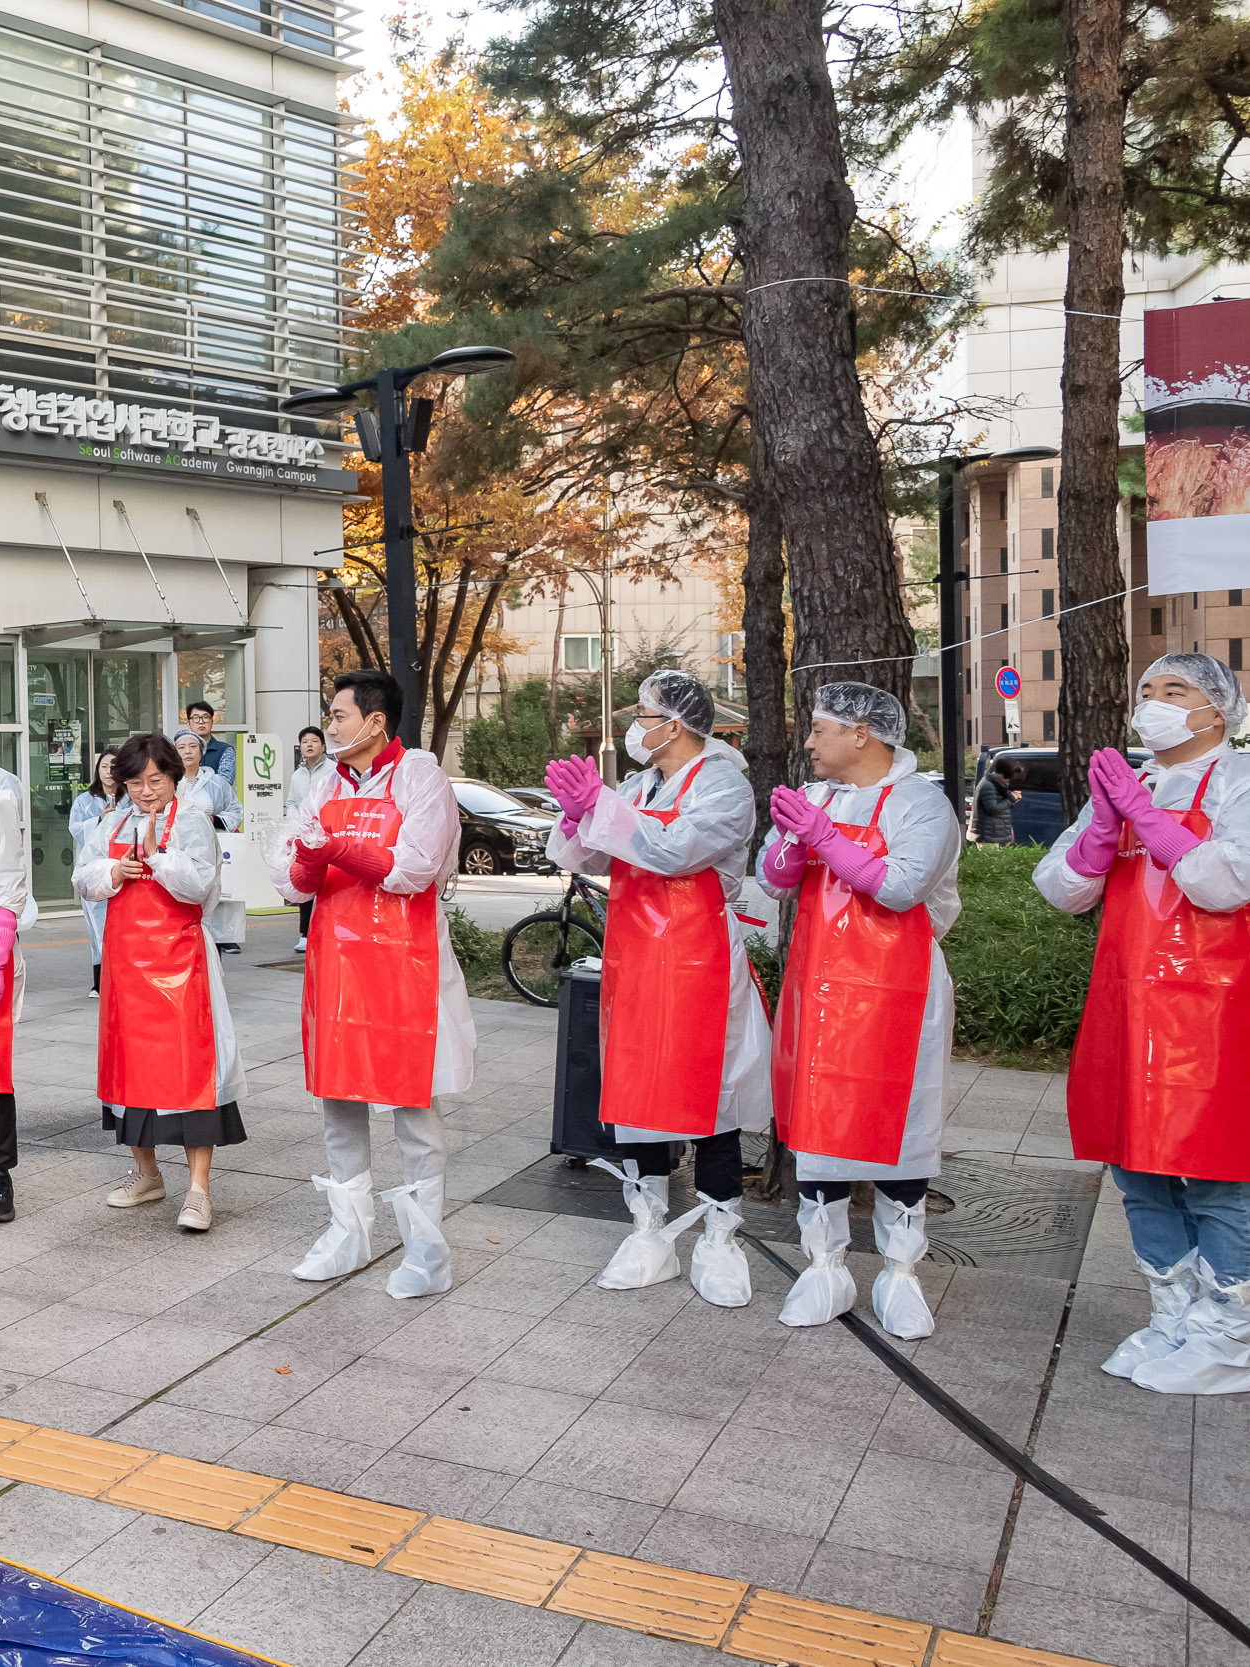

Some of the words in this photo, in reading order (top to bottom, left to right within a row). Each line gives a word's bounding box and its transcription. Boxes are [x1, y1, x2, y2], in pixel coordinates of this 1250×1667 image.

[78, 443, 111, 459] Seoul
[113, 446, 161, 465] Software
[165, 454, 219, 473] ACademy
[226, 461, 274, 479] Gwangjin
[277, 468, 317, 484] Campus
[225, 427, 326, 467] 광진캠퍼스
